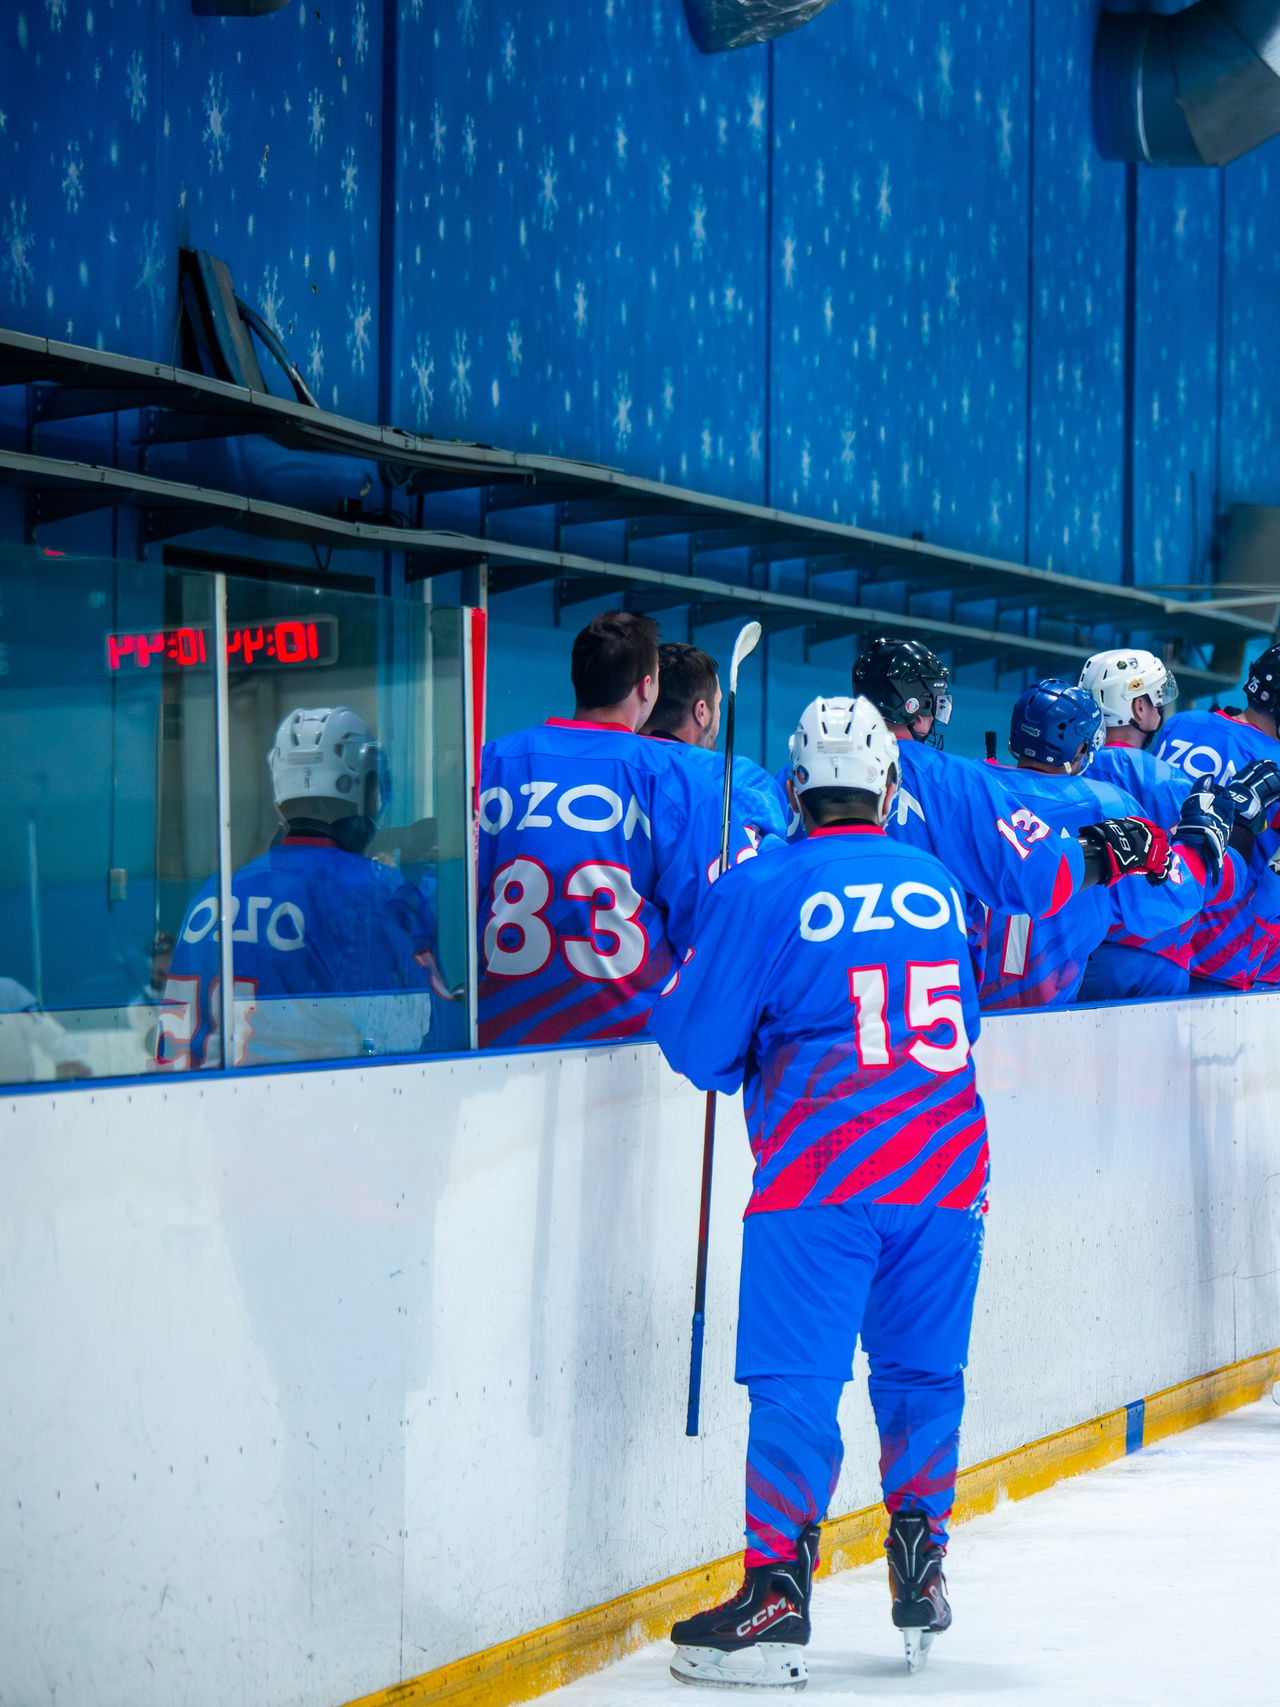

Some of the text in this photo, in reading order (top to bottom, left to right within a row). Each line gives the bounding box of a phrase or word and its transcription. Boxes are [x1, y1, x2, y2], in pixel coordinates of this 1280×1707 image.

[995, 807, 1051, 860] 13
[482, 855, 649, 984] 83
[801, 881, 967, 942] OZO
[848, 959, 974, 1077] 15
[736, 1597, 787, 1638] CCM
